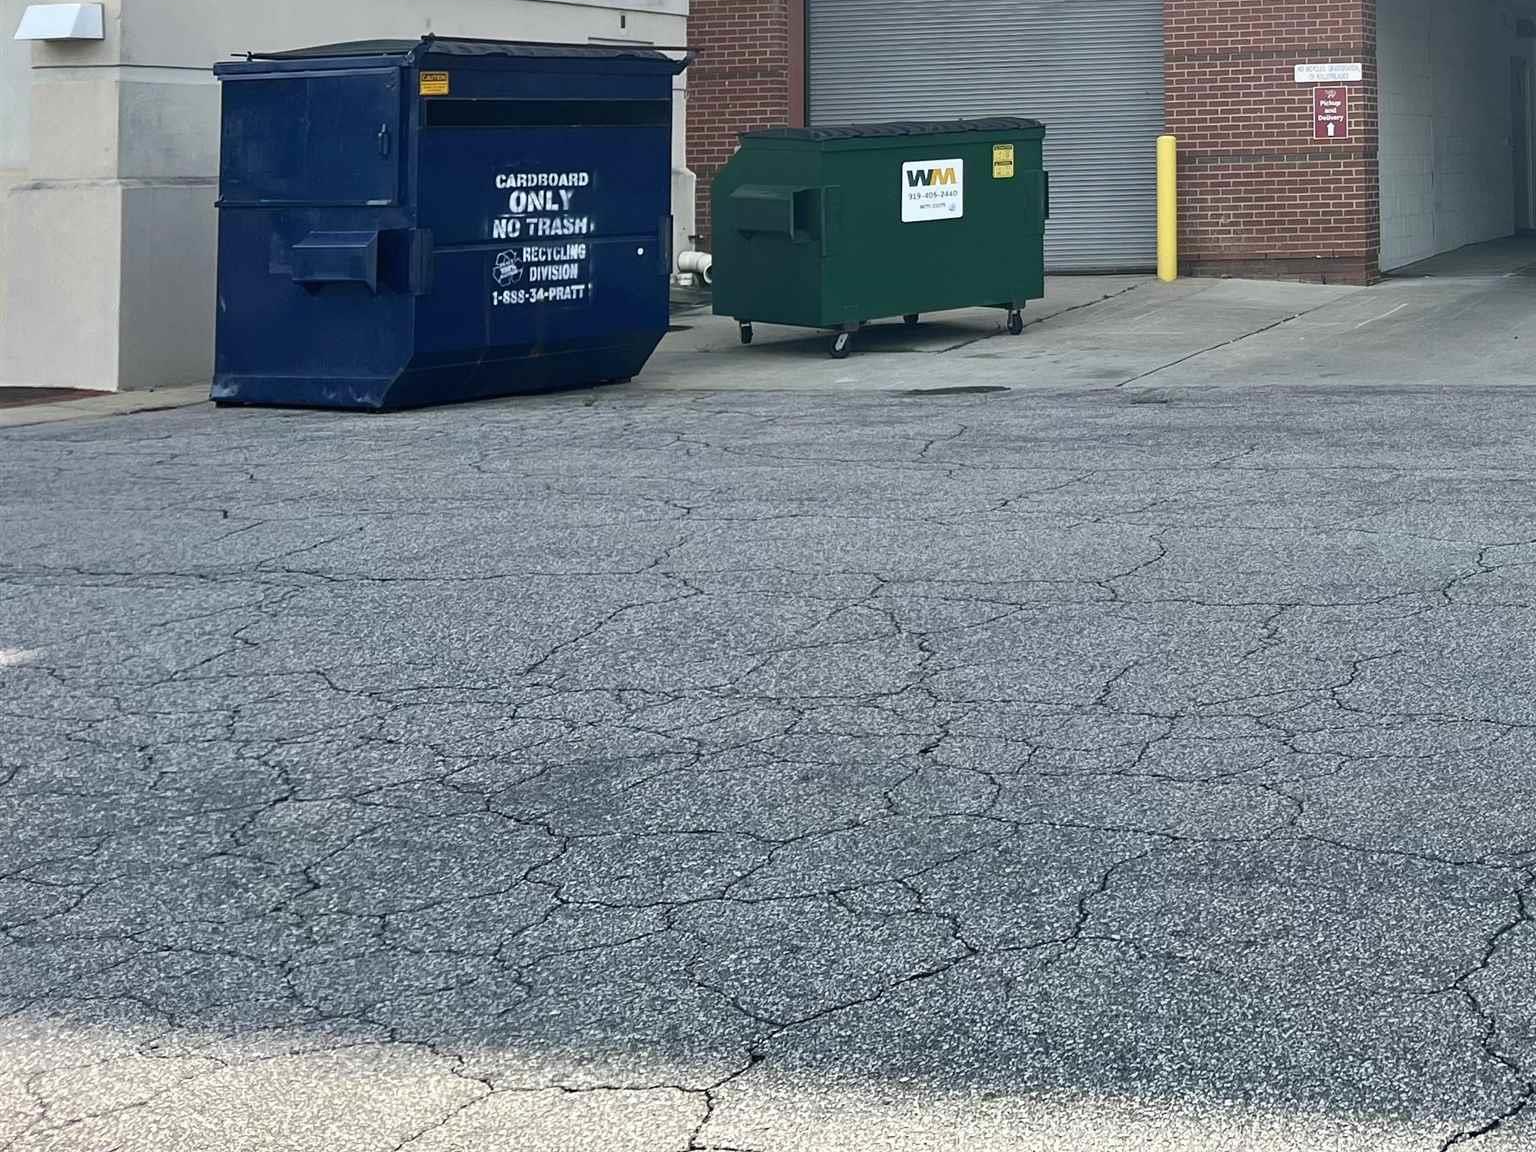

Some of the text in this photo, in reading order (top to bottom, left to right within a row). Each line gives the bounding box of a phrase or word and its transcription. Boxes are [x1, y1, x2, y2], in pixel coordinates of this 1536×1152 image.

[1320, 99, 1342, 107] Pickup
[1317, 114, 1344, 122] Delivery
[495, 172, 589, 188] CARDBOARD
[906, 167, 957, 187] WM
[509, 189, 575, 213] ONLY
[492, 218, 521, 239] NO
[526, 216, 588, 236] TRASH
[522, 243, 586, 262] RECYCLING
[529, 263, 578, 282] DIVISION
[492, 284, 585, 306] 1-888-34-PRATT
